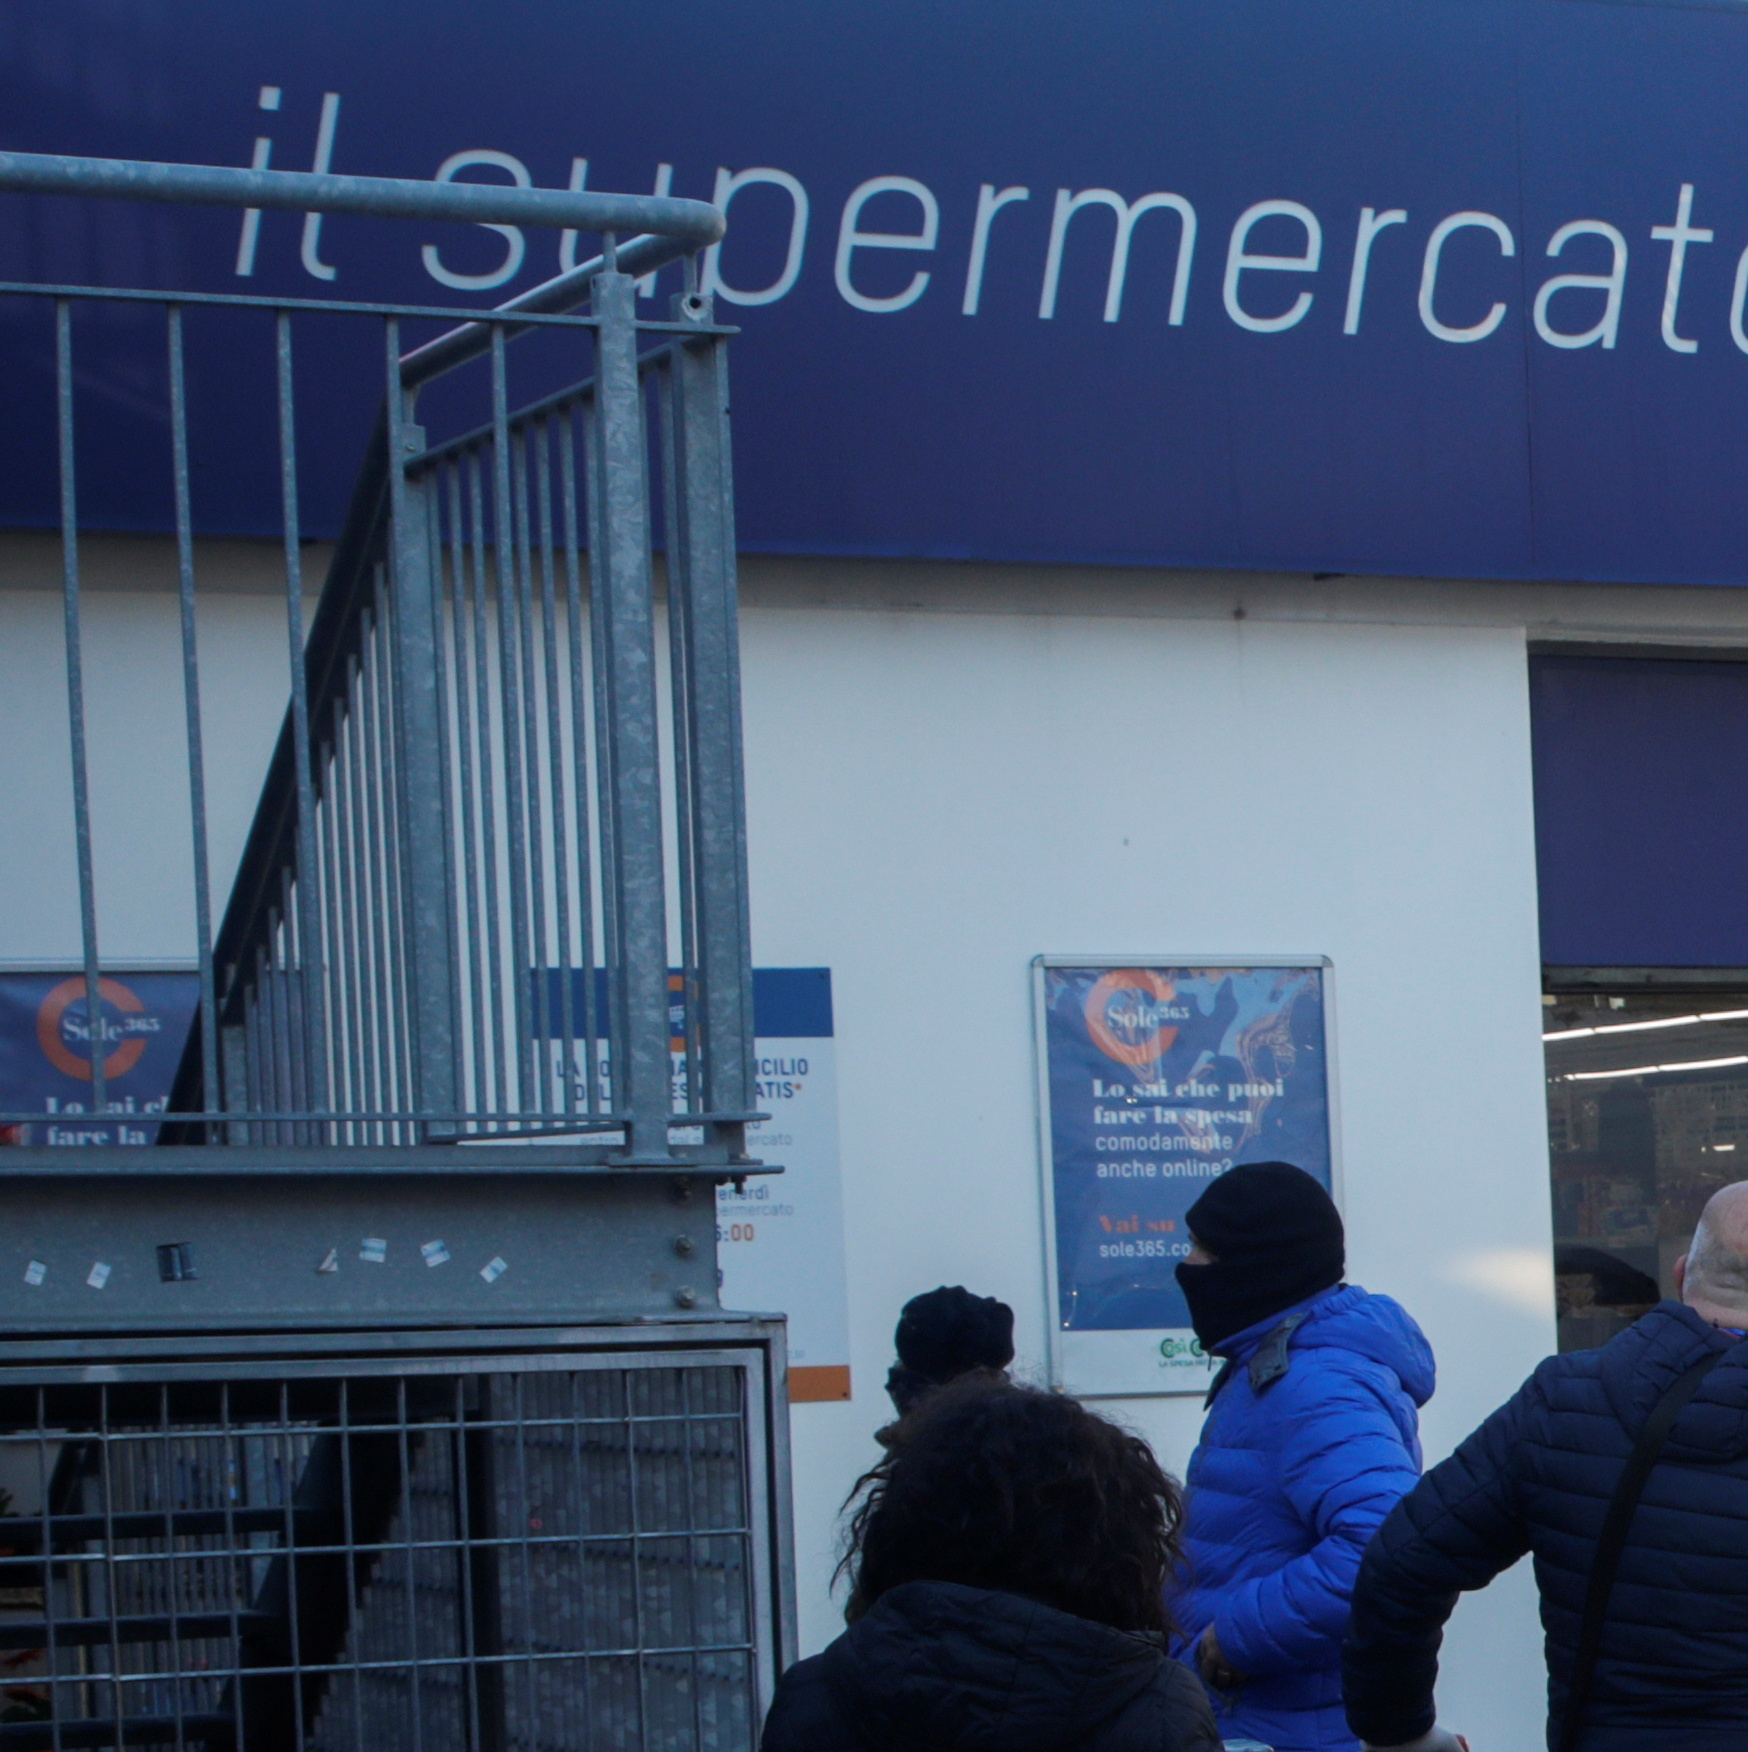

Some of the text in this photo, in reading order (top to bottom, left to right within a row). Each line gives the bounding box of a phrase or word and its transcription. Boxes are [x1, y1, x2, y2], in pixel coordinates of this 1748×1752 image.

[235, 85, 340, 282] il
[1093, 1078, 1284, 1102] Lo sai che puoi
[1094, 1105, 1252, 1129] fare la spesa
[118, 1125, 146, 1145] la
[1096, 1133, 1233, 1151] comodamente
[1097, 1158, 1234, 1178] anche online?
[1100, 1215, 1176, 1233] Vai su
[1100, 1240, 1191, 1258] sole365.co
